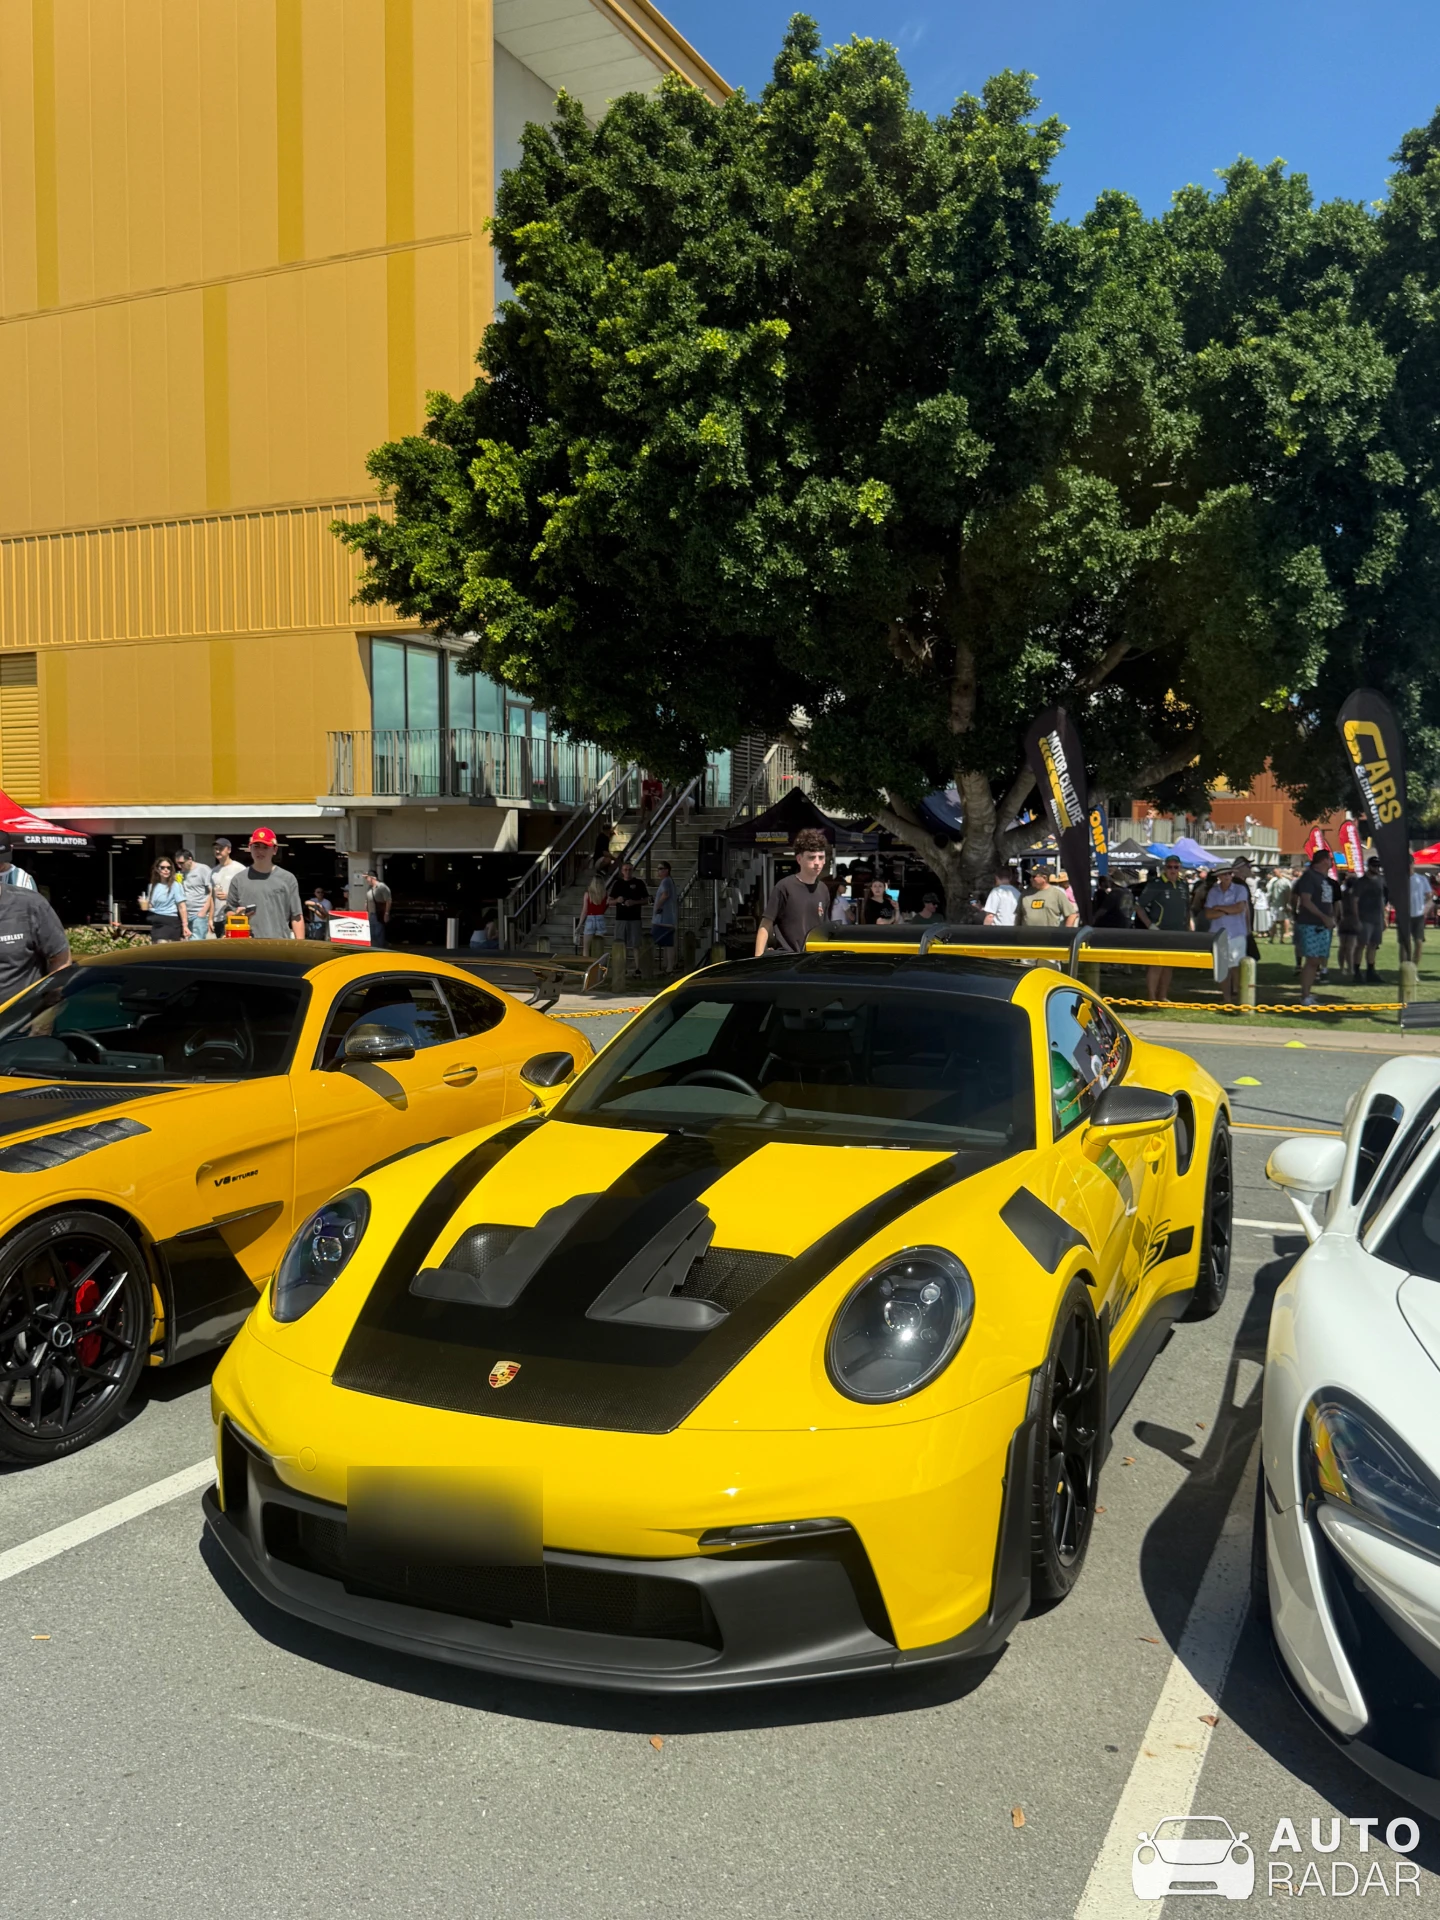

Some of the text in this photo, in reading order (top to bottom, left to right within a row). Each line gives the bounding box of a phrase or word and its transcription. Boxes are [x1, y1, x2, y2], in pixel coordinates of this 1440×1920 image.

[1046, 730, 1085, 827] MOTOR CULTURE
[1344, 720, 1402, 823] CARS
[24, 835, 88, 846] CAR SIMULATORS
[0, 933, 23, 942] VERLAST
[214, 1170, 259, 1187] V8 BITURBO
